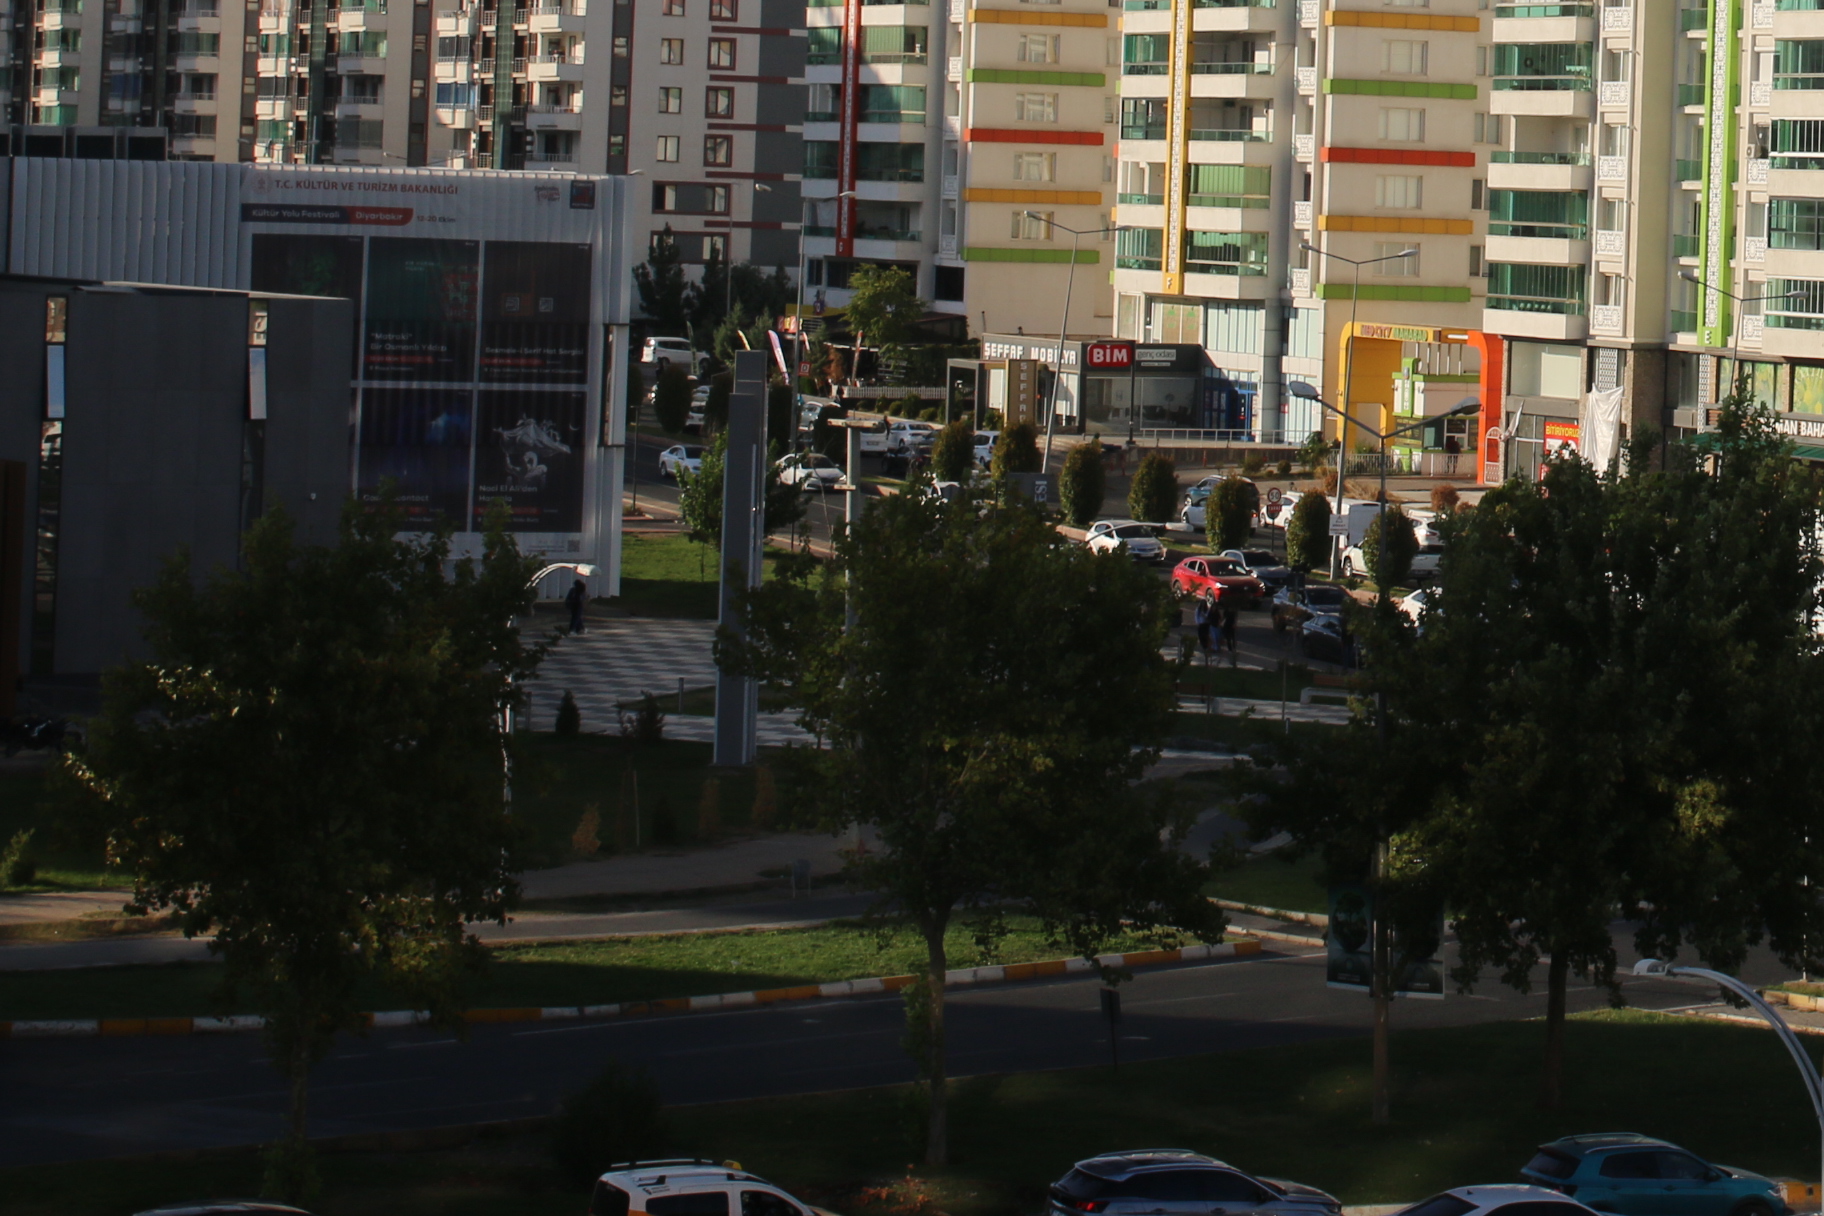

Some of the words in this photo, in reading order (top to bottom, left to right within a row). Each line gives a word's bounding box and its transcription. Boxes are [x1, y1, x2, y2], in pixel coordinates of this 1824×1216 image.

[275, 180, 293, 189] T.C.
[296, 179, 338, 190] KÜLTÜR
[341, 182, 354, 191] VE
[357, 181, 398, 192] TURİZM
[400, 184, 458, 195] BAKANLIĞI
[252, 209, 279, 217] Kültür
[282, 209, 300, 218] Yolu
[301, 210, 340, 218] Festivali
[355, 211, 403, 221] Diyarbakır
[1704, 330, 1712, 344] E
[984, 342, 1024, 360] ŞEFFAF
[1030, 345, 1077, 365] MOBİYA
[1092, 345, 1128, 363] BİM
[1270, 491, 1280, 500] 50
